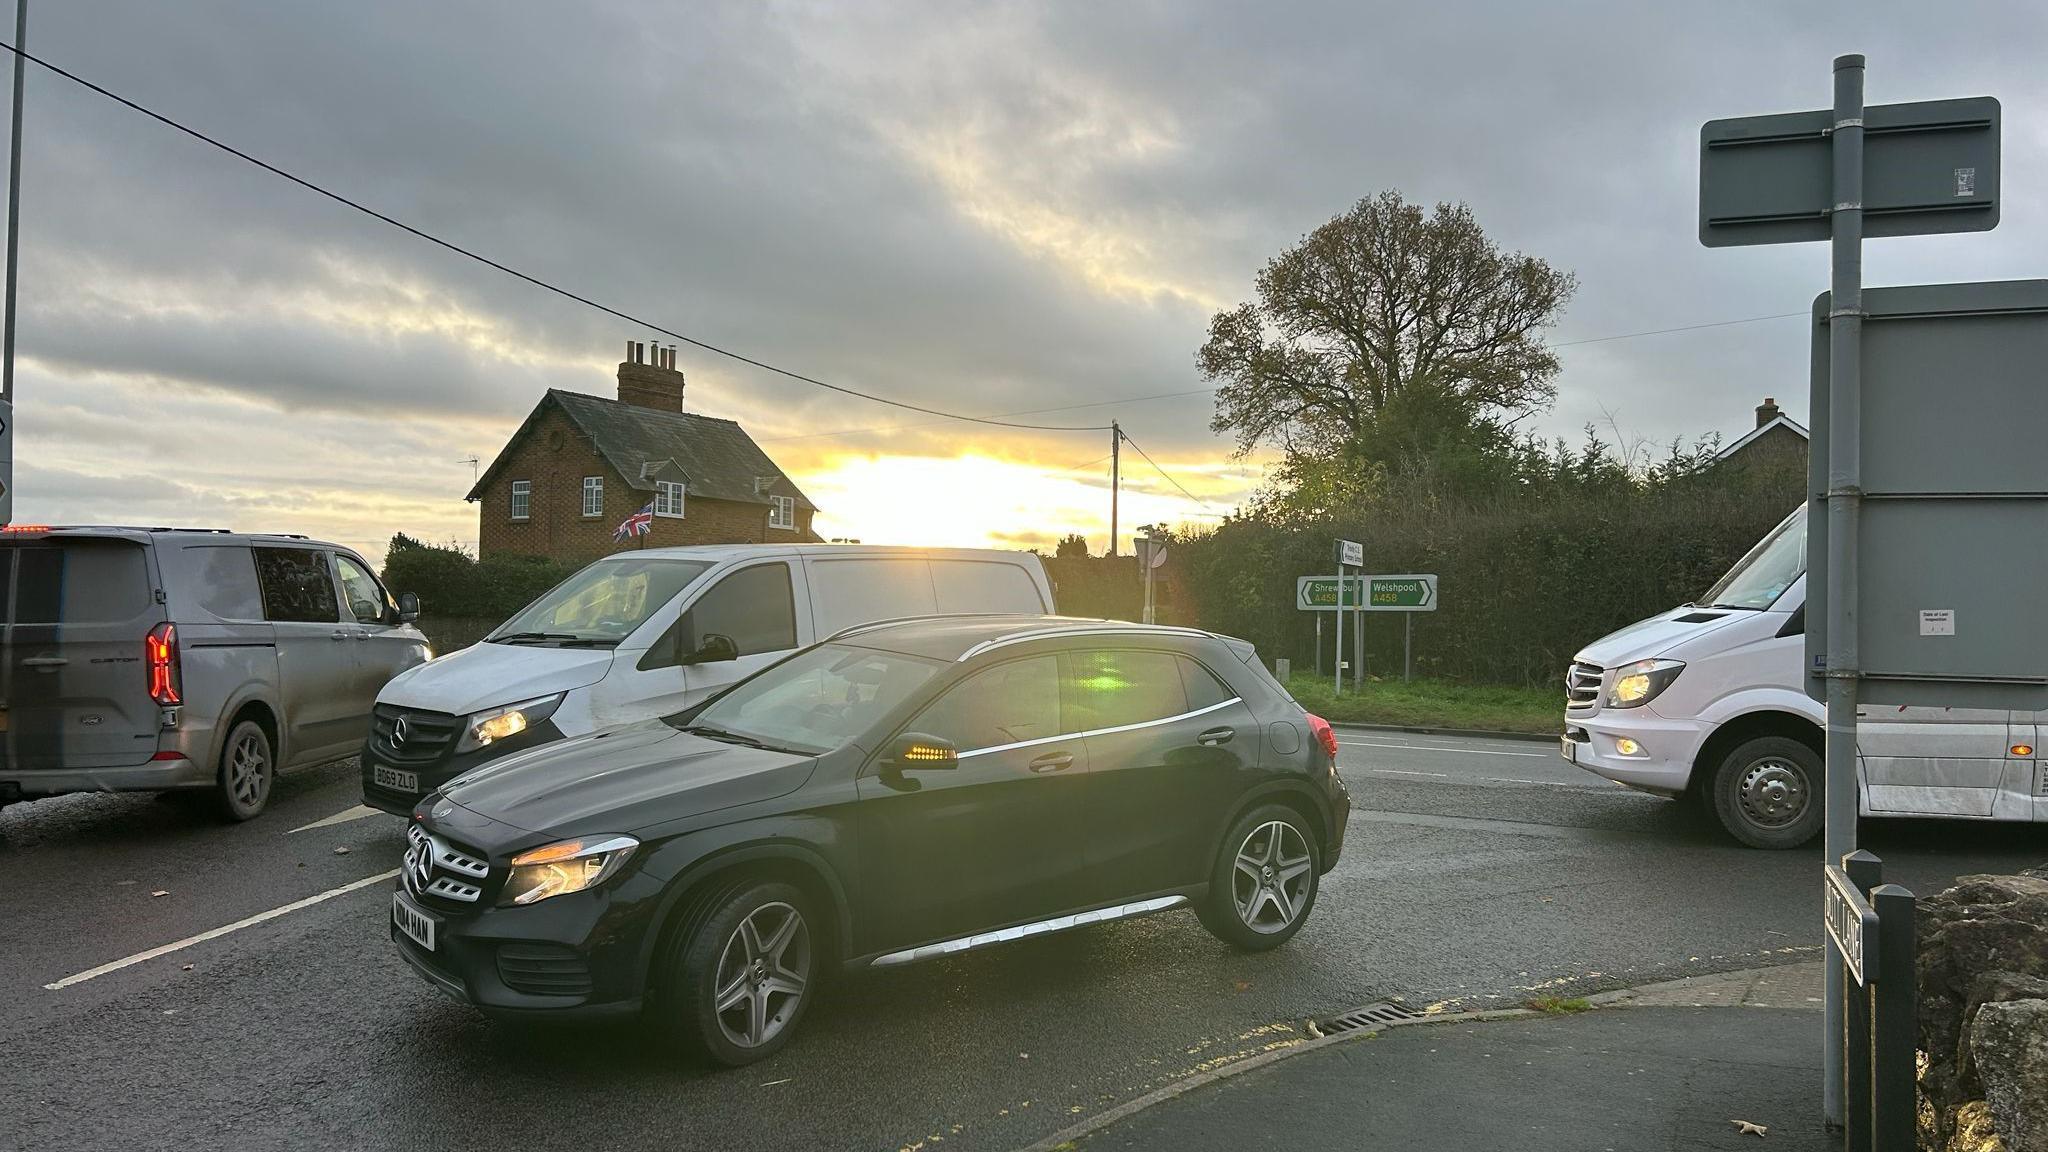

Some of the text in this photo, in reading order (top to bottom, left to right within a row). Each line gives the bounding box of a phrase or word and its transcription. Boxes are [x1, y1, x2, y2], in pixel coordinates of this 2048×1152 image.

[1315, 583, 1361, 594] Shrewbuy
[1373, 583, 1417, 593] Welshpool
[1314, 594, 1337, 602] A458
[1373, 593, 1397, 602] A458
[410, 912, 429, 945] HAN
